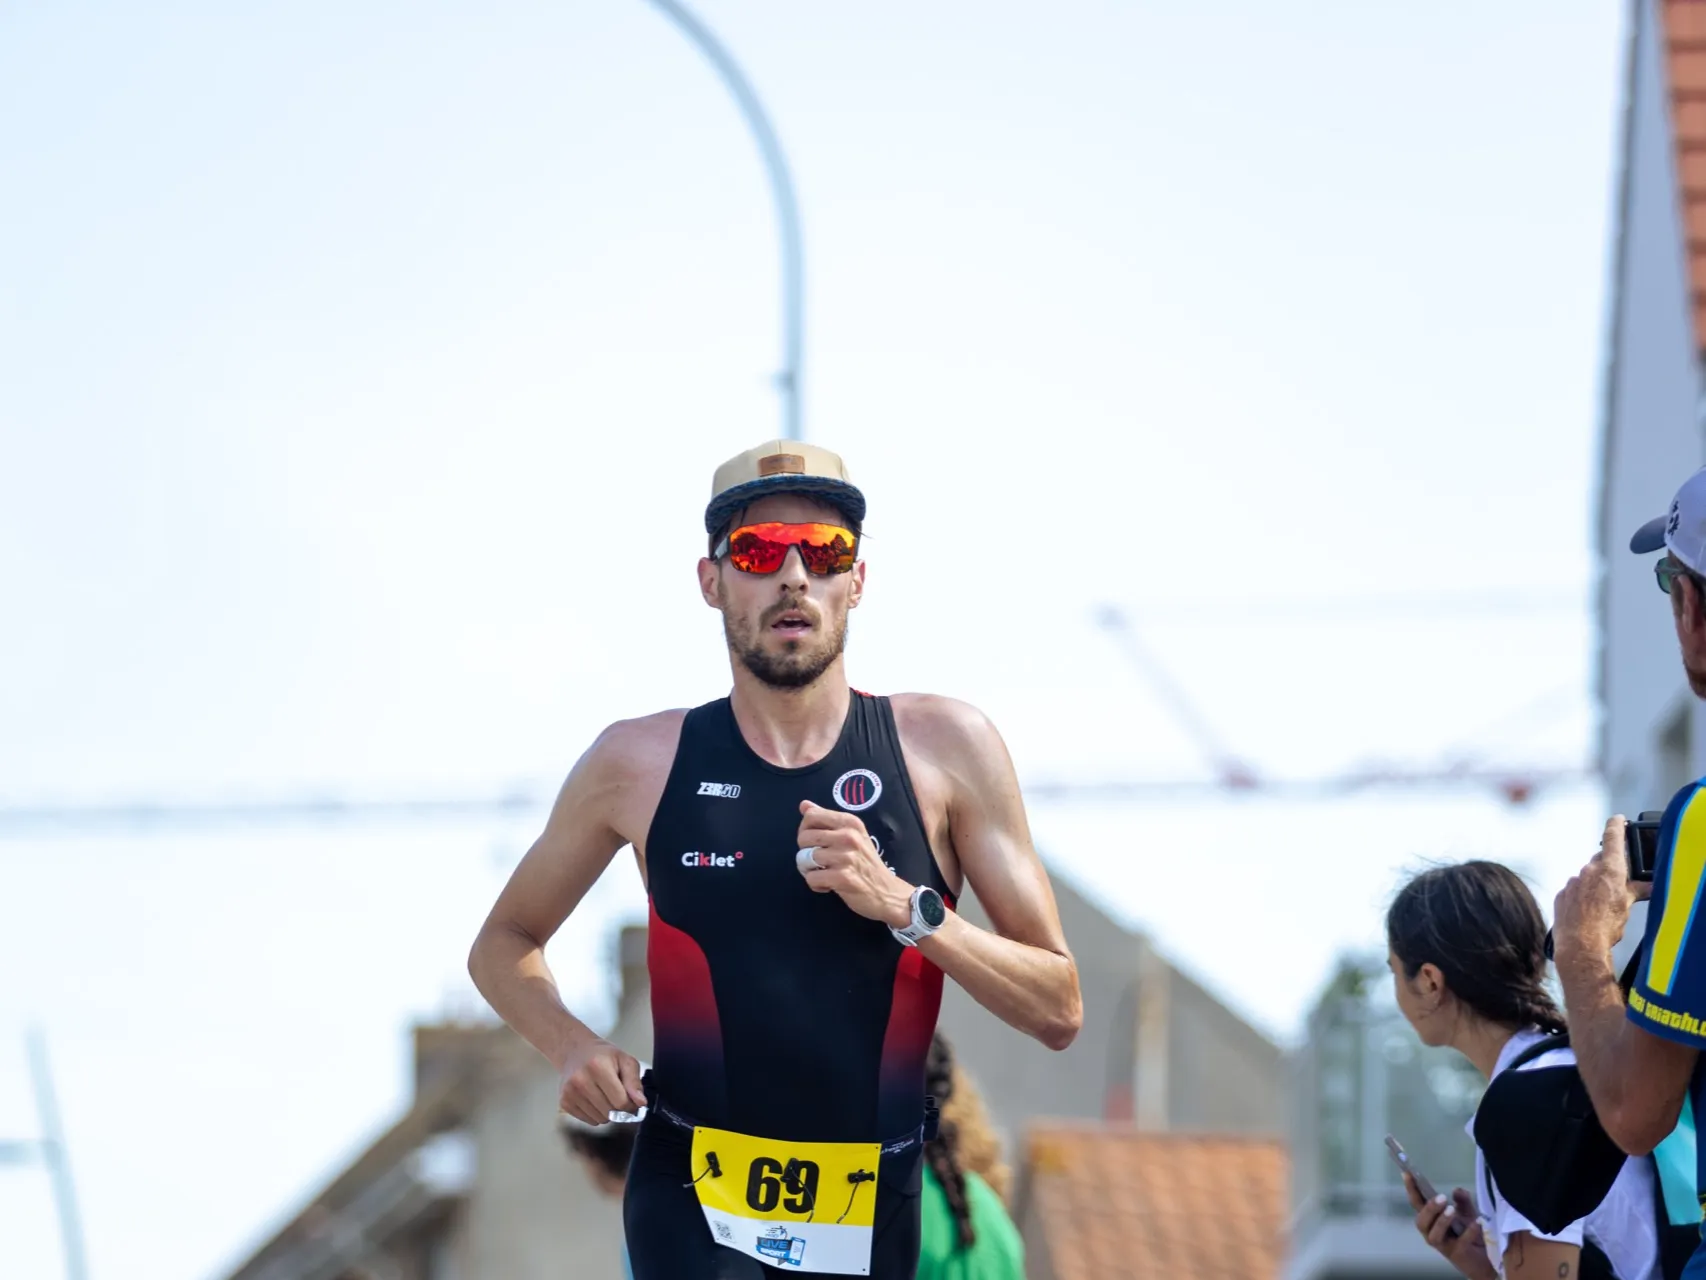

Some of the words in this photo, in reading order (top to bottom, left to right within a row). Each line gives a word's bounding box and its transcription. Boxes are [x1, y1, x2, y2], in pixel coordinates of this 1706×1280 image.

[745, 1156, 820, 1214] 69
[761, 1239, 788, 1249] LIVE
[760, 1248, 786, 1257] SPORT
